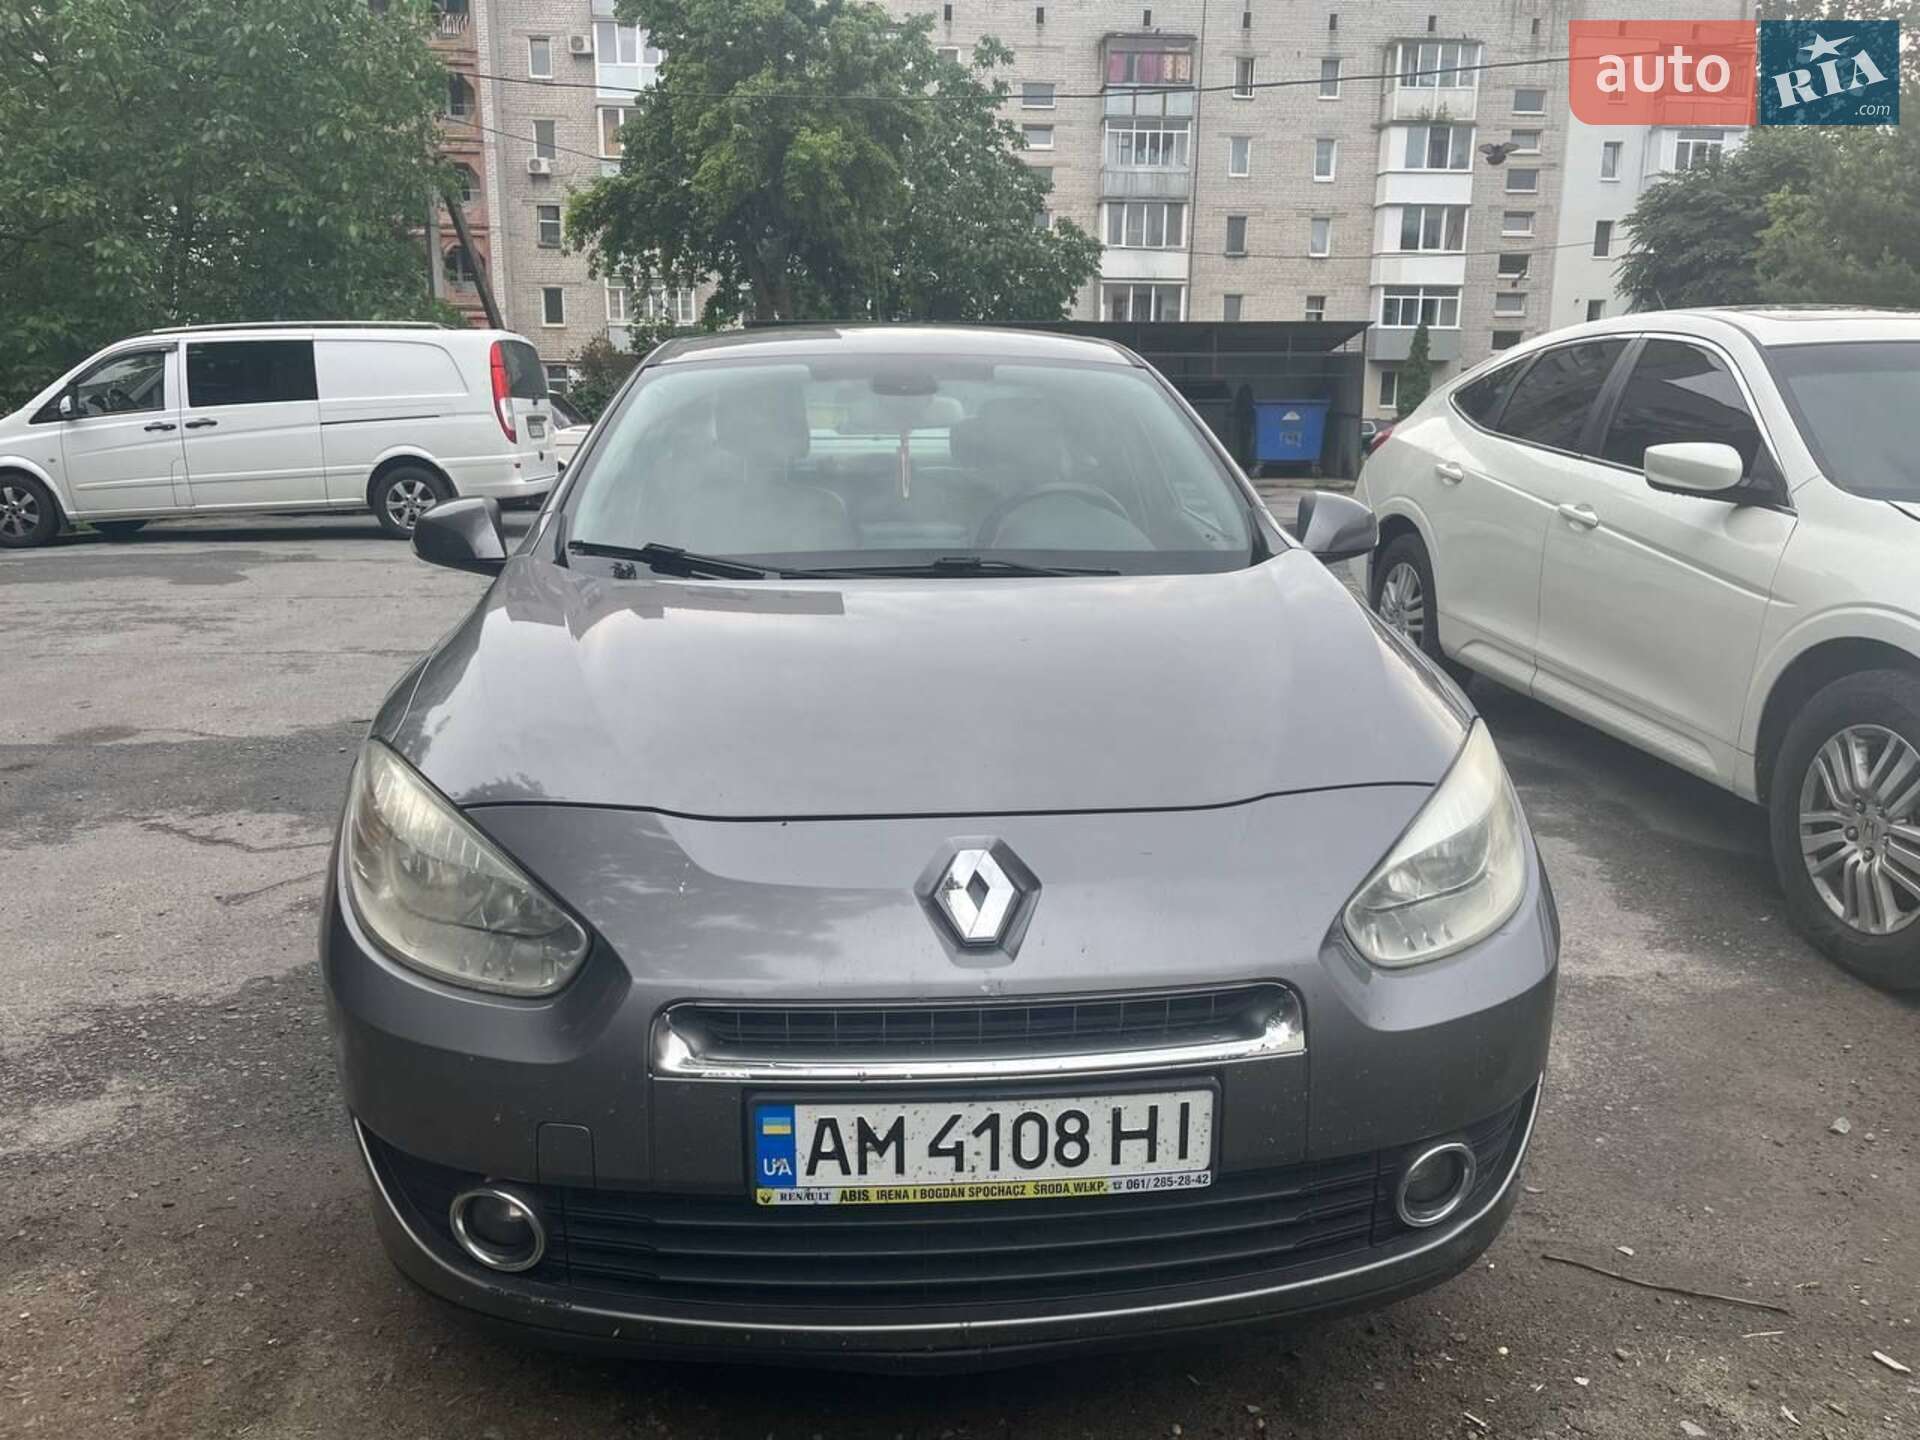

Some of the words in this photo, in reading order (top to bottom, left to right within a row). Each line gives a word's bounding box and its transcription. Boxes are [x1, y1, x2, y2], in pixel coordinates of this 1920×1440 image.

[805, 1116, 905, 1176] AM
[928, 1109, 1090, 1173] 4108
[1111, 1102, 1190, 1165] HI
[763, 1158, 793, 1176] UA
[780, 1191, 831, 1201] RENAULT
[840, 1189, 870, 1202] ABIS
[876, 1189, 910, 1201] IRENA
[920, 1187, 966, 1200] BOGDAN
[968, 1184, 1026, 1198] SPOCHACZ
